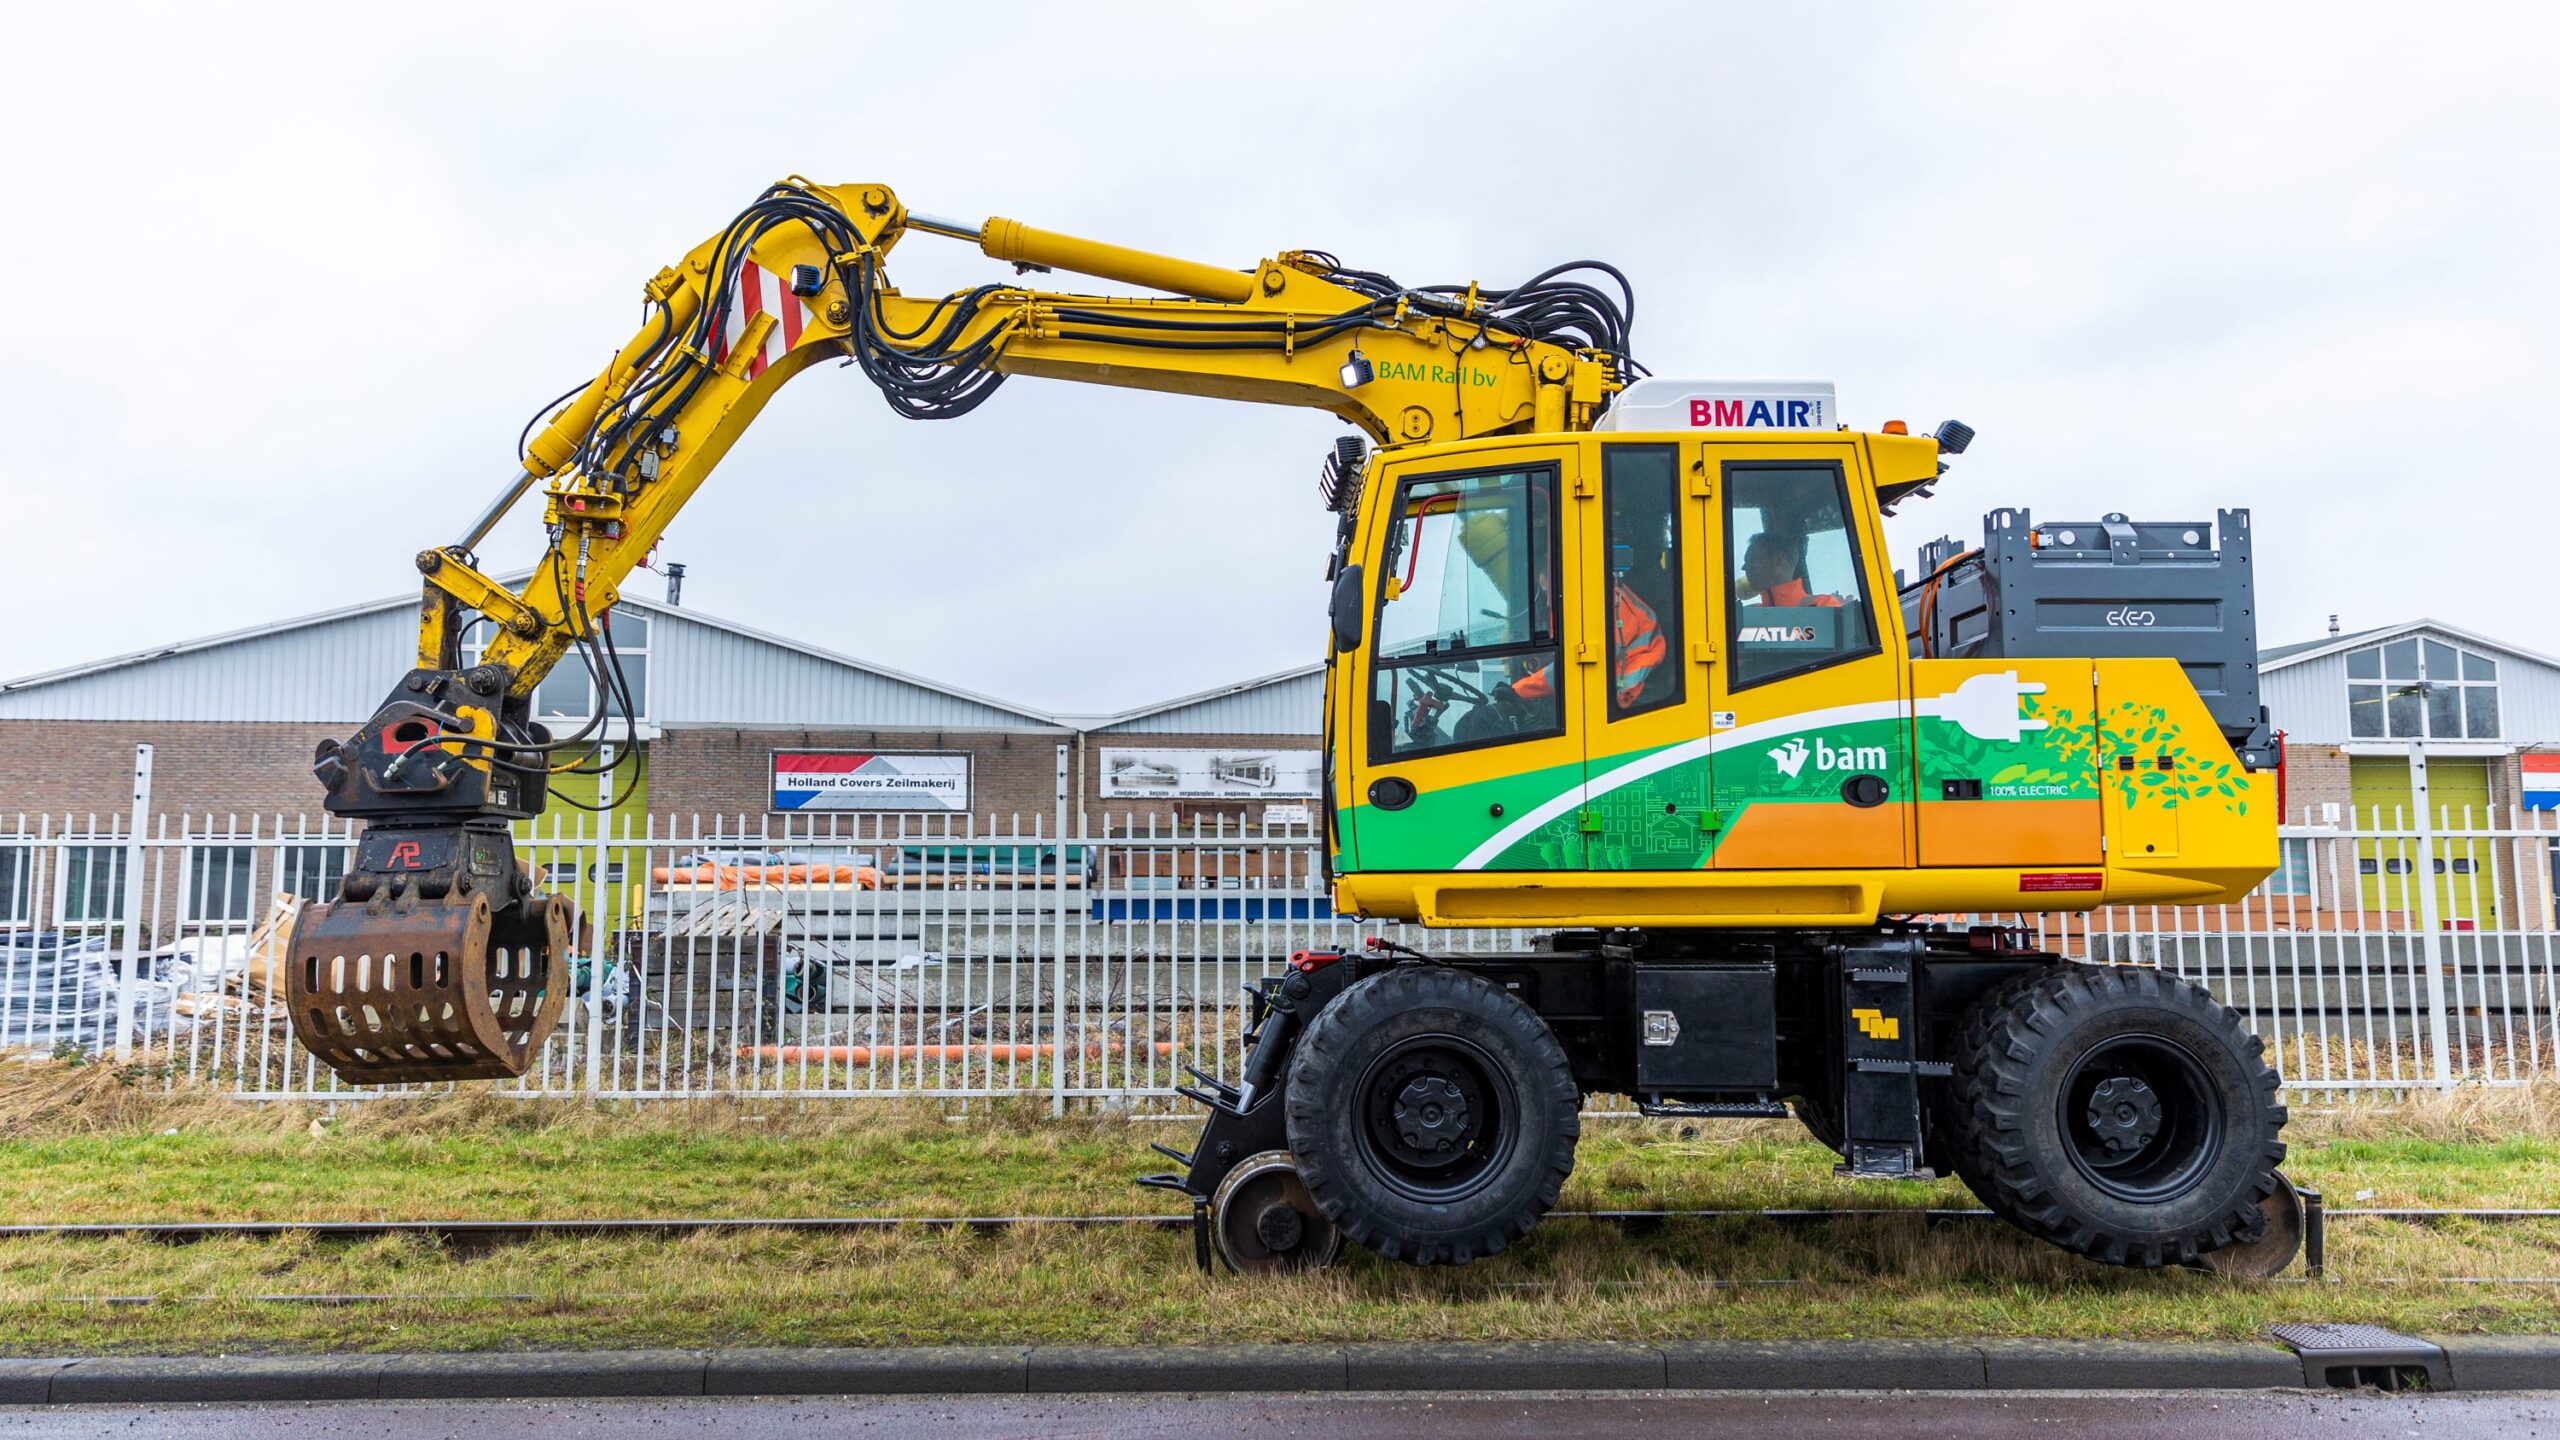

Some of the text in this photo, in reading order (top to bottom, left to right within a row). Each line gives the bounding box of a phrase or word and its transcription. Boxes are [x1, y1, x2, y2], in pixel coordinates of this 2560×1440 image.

[1379, 361, 1426, 382] BAM
[1473, 368, 1497, 387] bv
[1690, 400, 1809, 427] BMAIR
[1754, 626, 1816, 642] ATLAS
[1816, 737, 1887, 771] bam
[788, 777, 956, 790] Holland Covers Zeilmakerij
[1990, 785, 2068, 796] 100% ELECTRIC
[1852, 1008, 1899, 1039] TM
